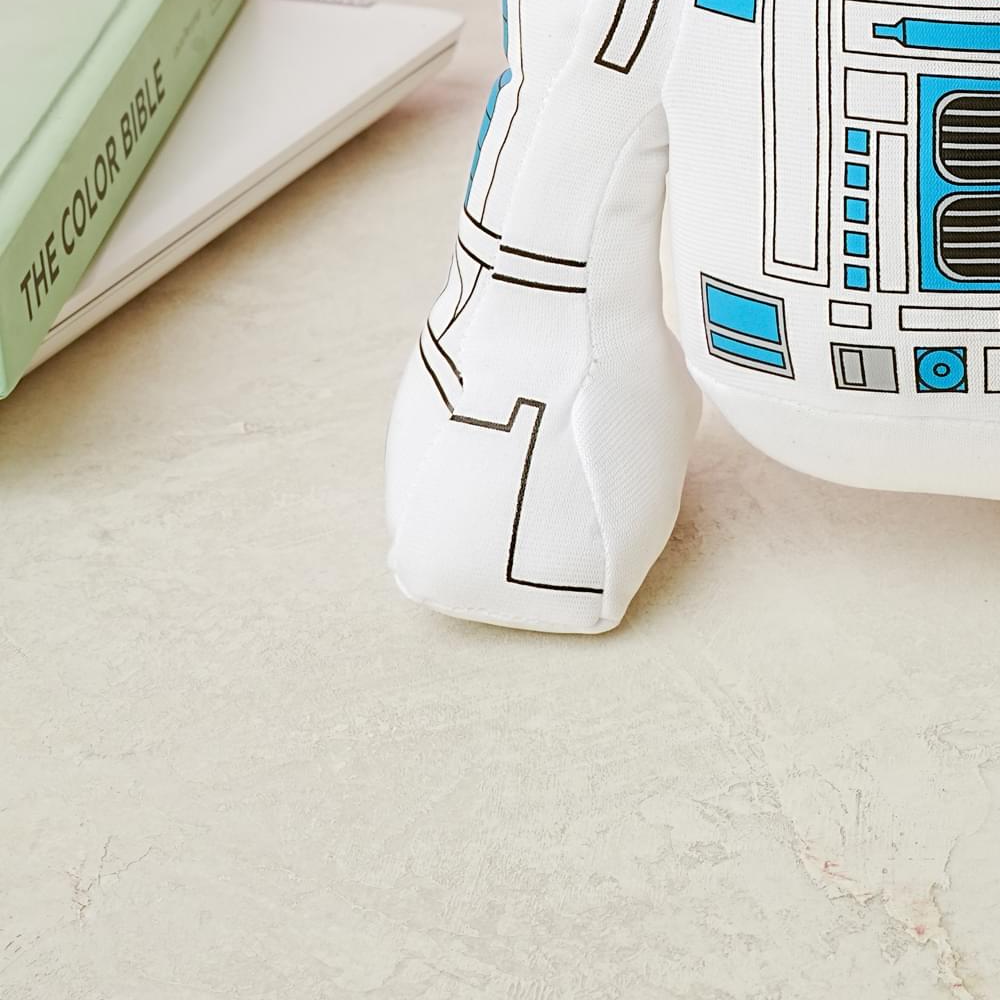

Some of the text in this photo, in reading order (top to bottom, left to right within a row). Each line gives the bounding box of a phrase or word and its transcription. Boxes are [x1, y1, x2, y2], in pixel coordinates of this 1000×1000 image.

[20, 59, 166, 321] THE COLOR BIBLE
